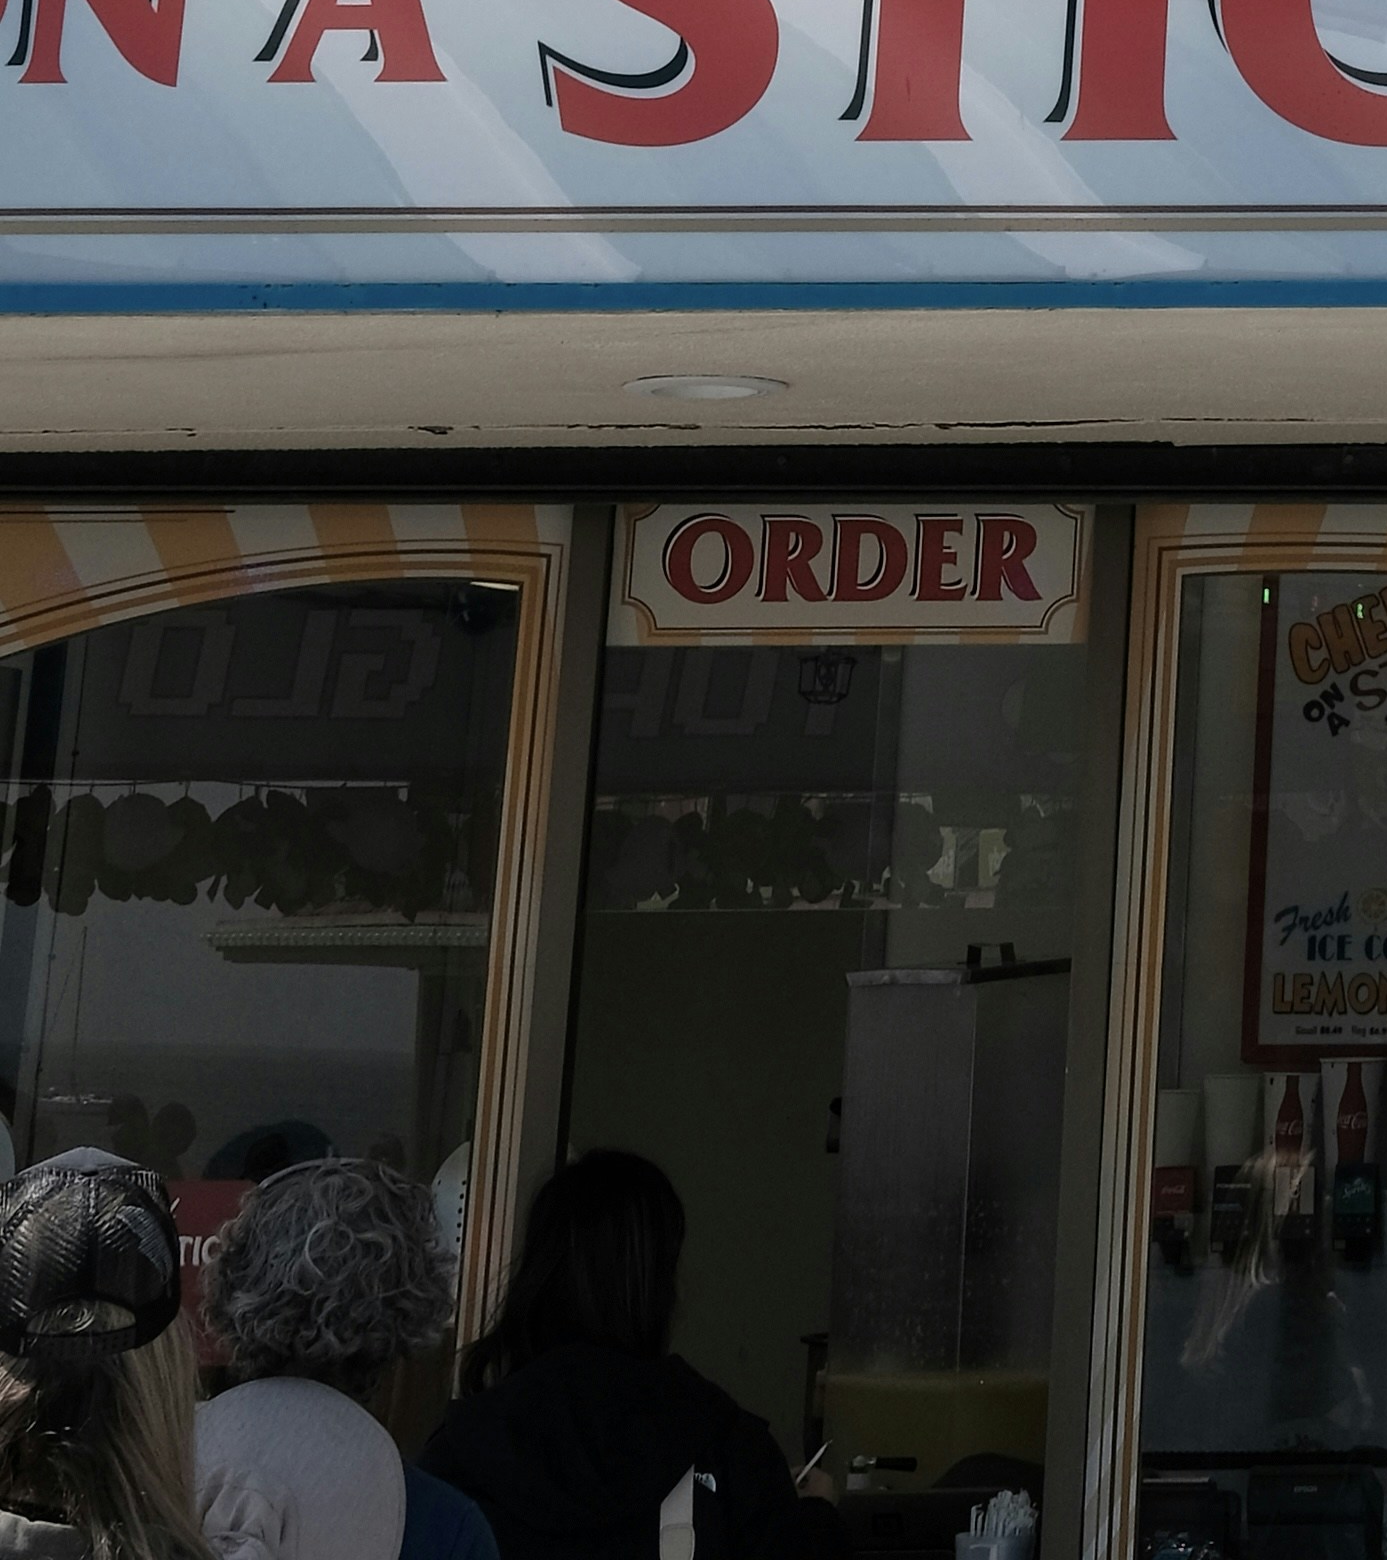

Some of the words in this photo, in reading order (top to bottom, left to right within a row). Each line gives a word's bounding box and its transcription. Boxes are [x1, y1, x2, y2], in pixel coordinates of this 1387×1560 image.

[661, 512, 1043, 605] ORDER
[1303, 682, 1345, 722] ON
[1326, 710, 1351, 737] A
[1275, 890, 1351, 946] Fresh
[1307, 934, 1353, 961] ICE
